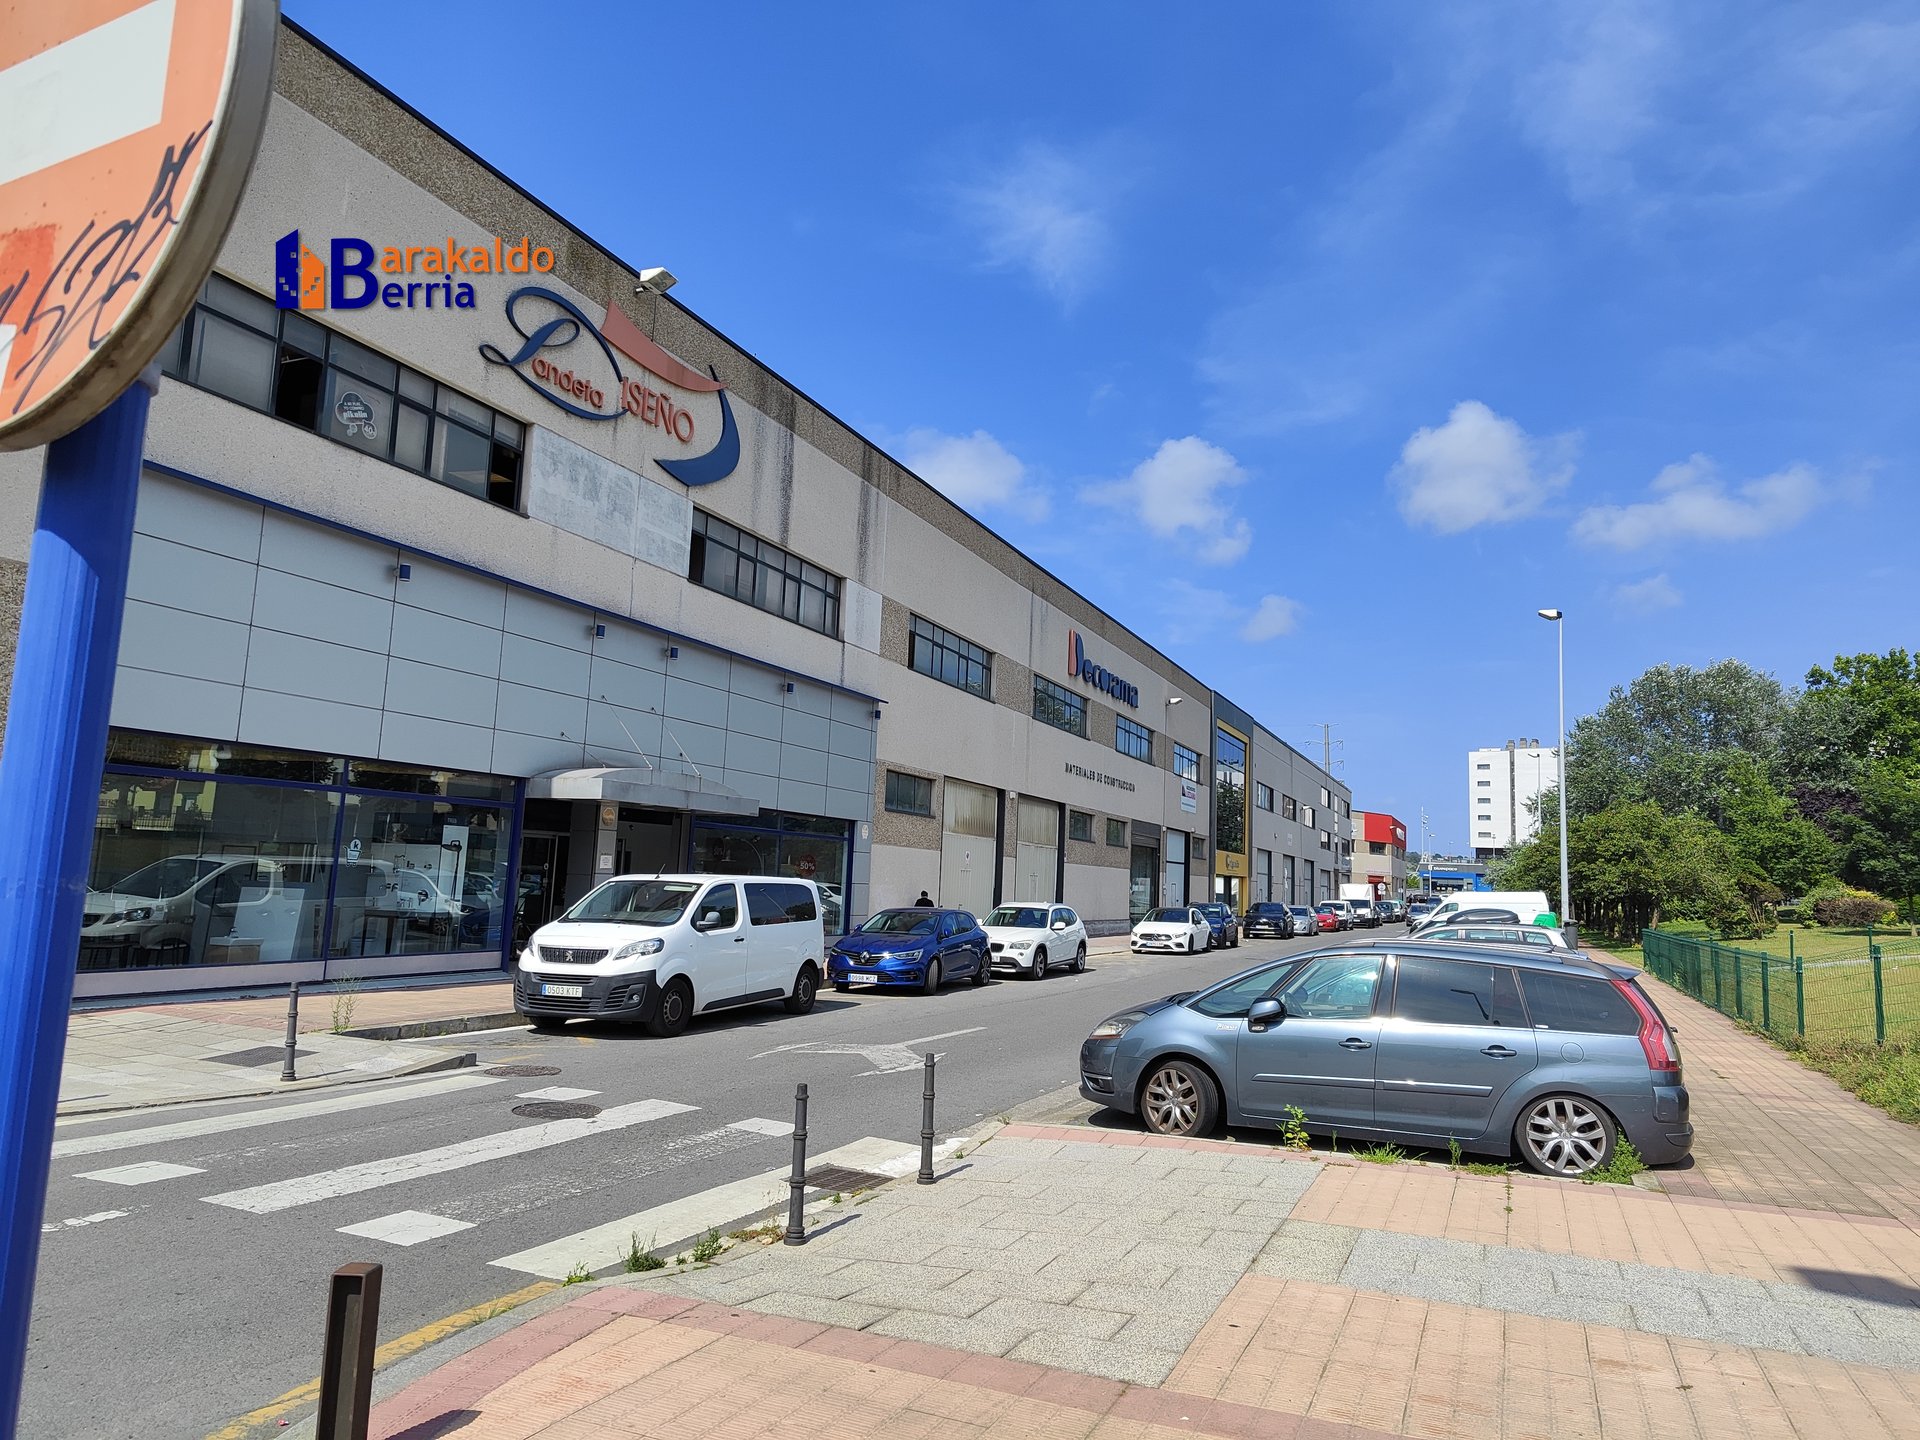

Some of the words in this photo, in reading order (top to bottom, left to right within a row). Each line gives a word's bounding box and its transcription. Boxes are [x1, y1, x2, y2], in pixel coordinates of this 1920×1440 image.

[1067, 629, 1139, 708] Decorama
[1065, 762, 1096, 781] MATERIALES
[1096, 772, 1103, 784] DE
[1103, 774, 1136, 793] CONSTRUCCION
[800, 862, 815, 870] 50%
